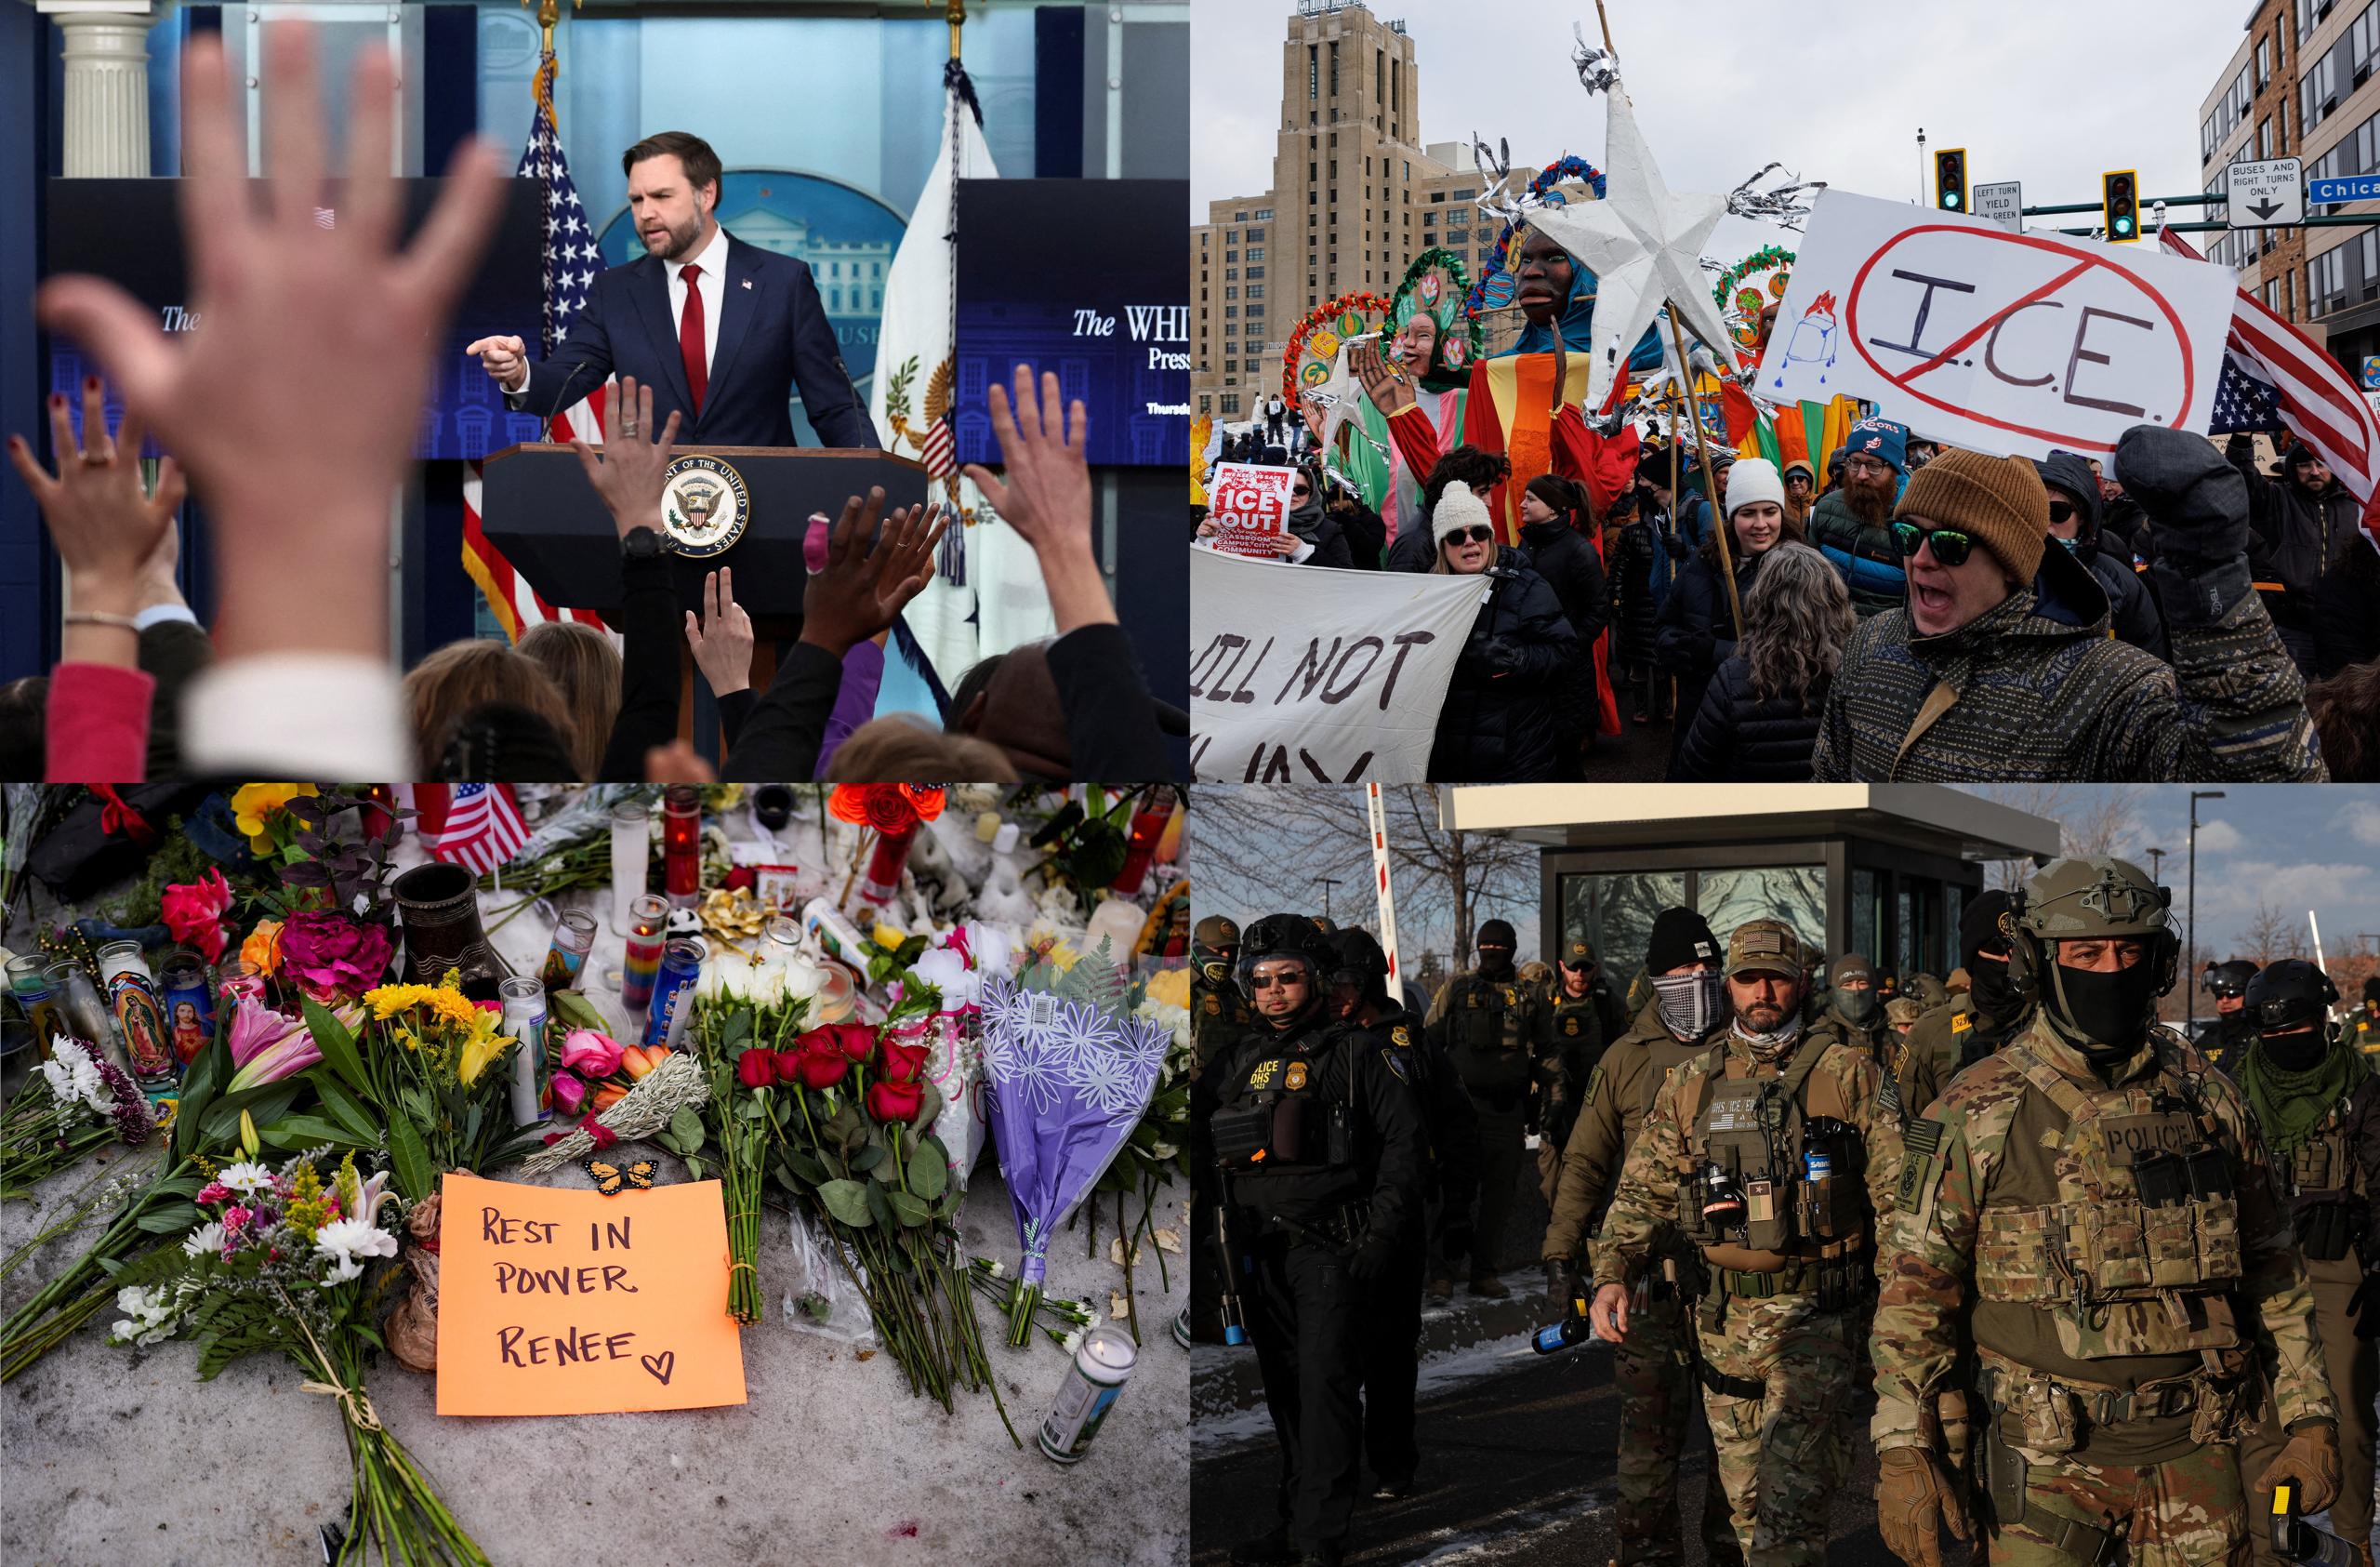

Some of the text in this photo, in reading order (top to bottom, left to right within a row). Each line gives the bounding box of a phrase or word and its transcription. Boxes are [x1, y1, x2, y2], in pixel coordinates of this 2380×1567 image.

[2233, 163, 2294, 176] BUSES AND
[2234, 174, 2294, 186] RIGHT TURNS
[1977, 186, 2016, 197] LEFT TURN
[2250, 187, 2278, 196] ONLY
[1986, 198, 2010, 209] YIELD
[1993, 211, 2016, 219] GREEN
[162, 305, 201, 332] The
[1073, 305, 1190, 342] The WHI
[1852, 417, 1899, 433] Loons
[682, 459, 694, 469] OF
[697, 459, 716, 470] THE
[720, 466, 747, 508] UNITED
[1224, 488, 1277, 511] ICE
[1220, 511, 1276, 531] OUT
[714, 513, 747, 551] STATES
[1218, 533, 1271, 542] CLASSROOM
[1217, 546, 1273, 555] COMMUNITY
[1274, 631, 1436, 711] NOT
[1250, 1072, 1270, 1084] DHS
[2107, 1125, 2187, 1154] POLICE
[1908, 1153, 1921, 1165] ICE
[482, 1207, 630, 1251] REST IN
[493, 1262, 639, 1295] POWER
[496, 1325, 636, 1368] RENEE
